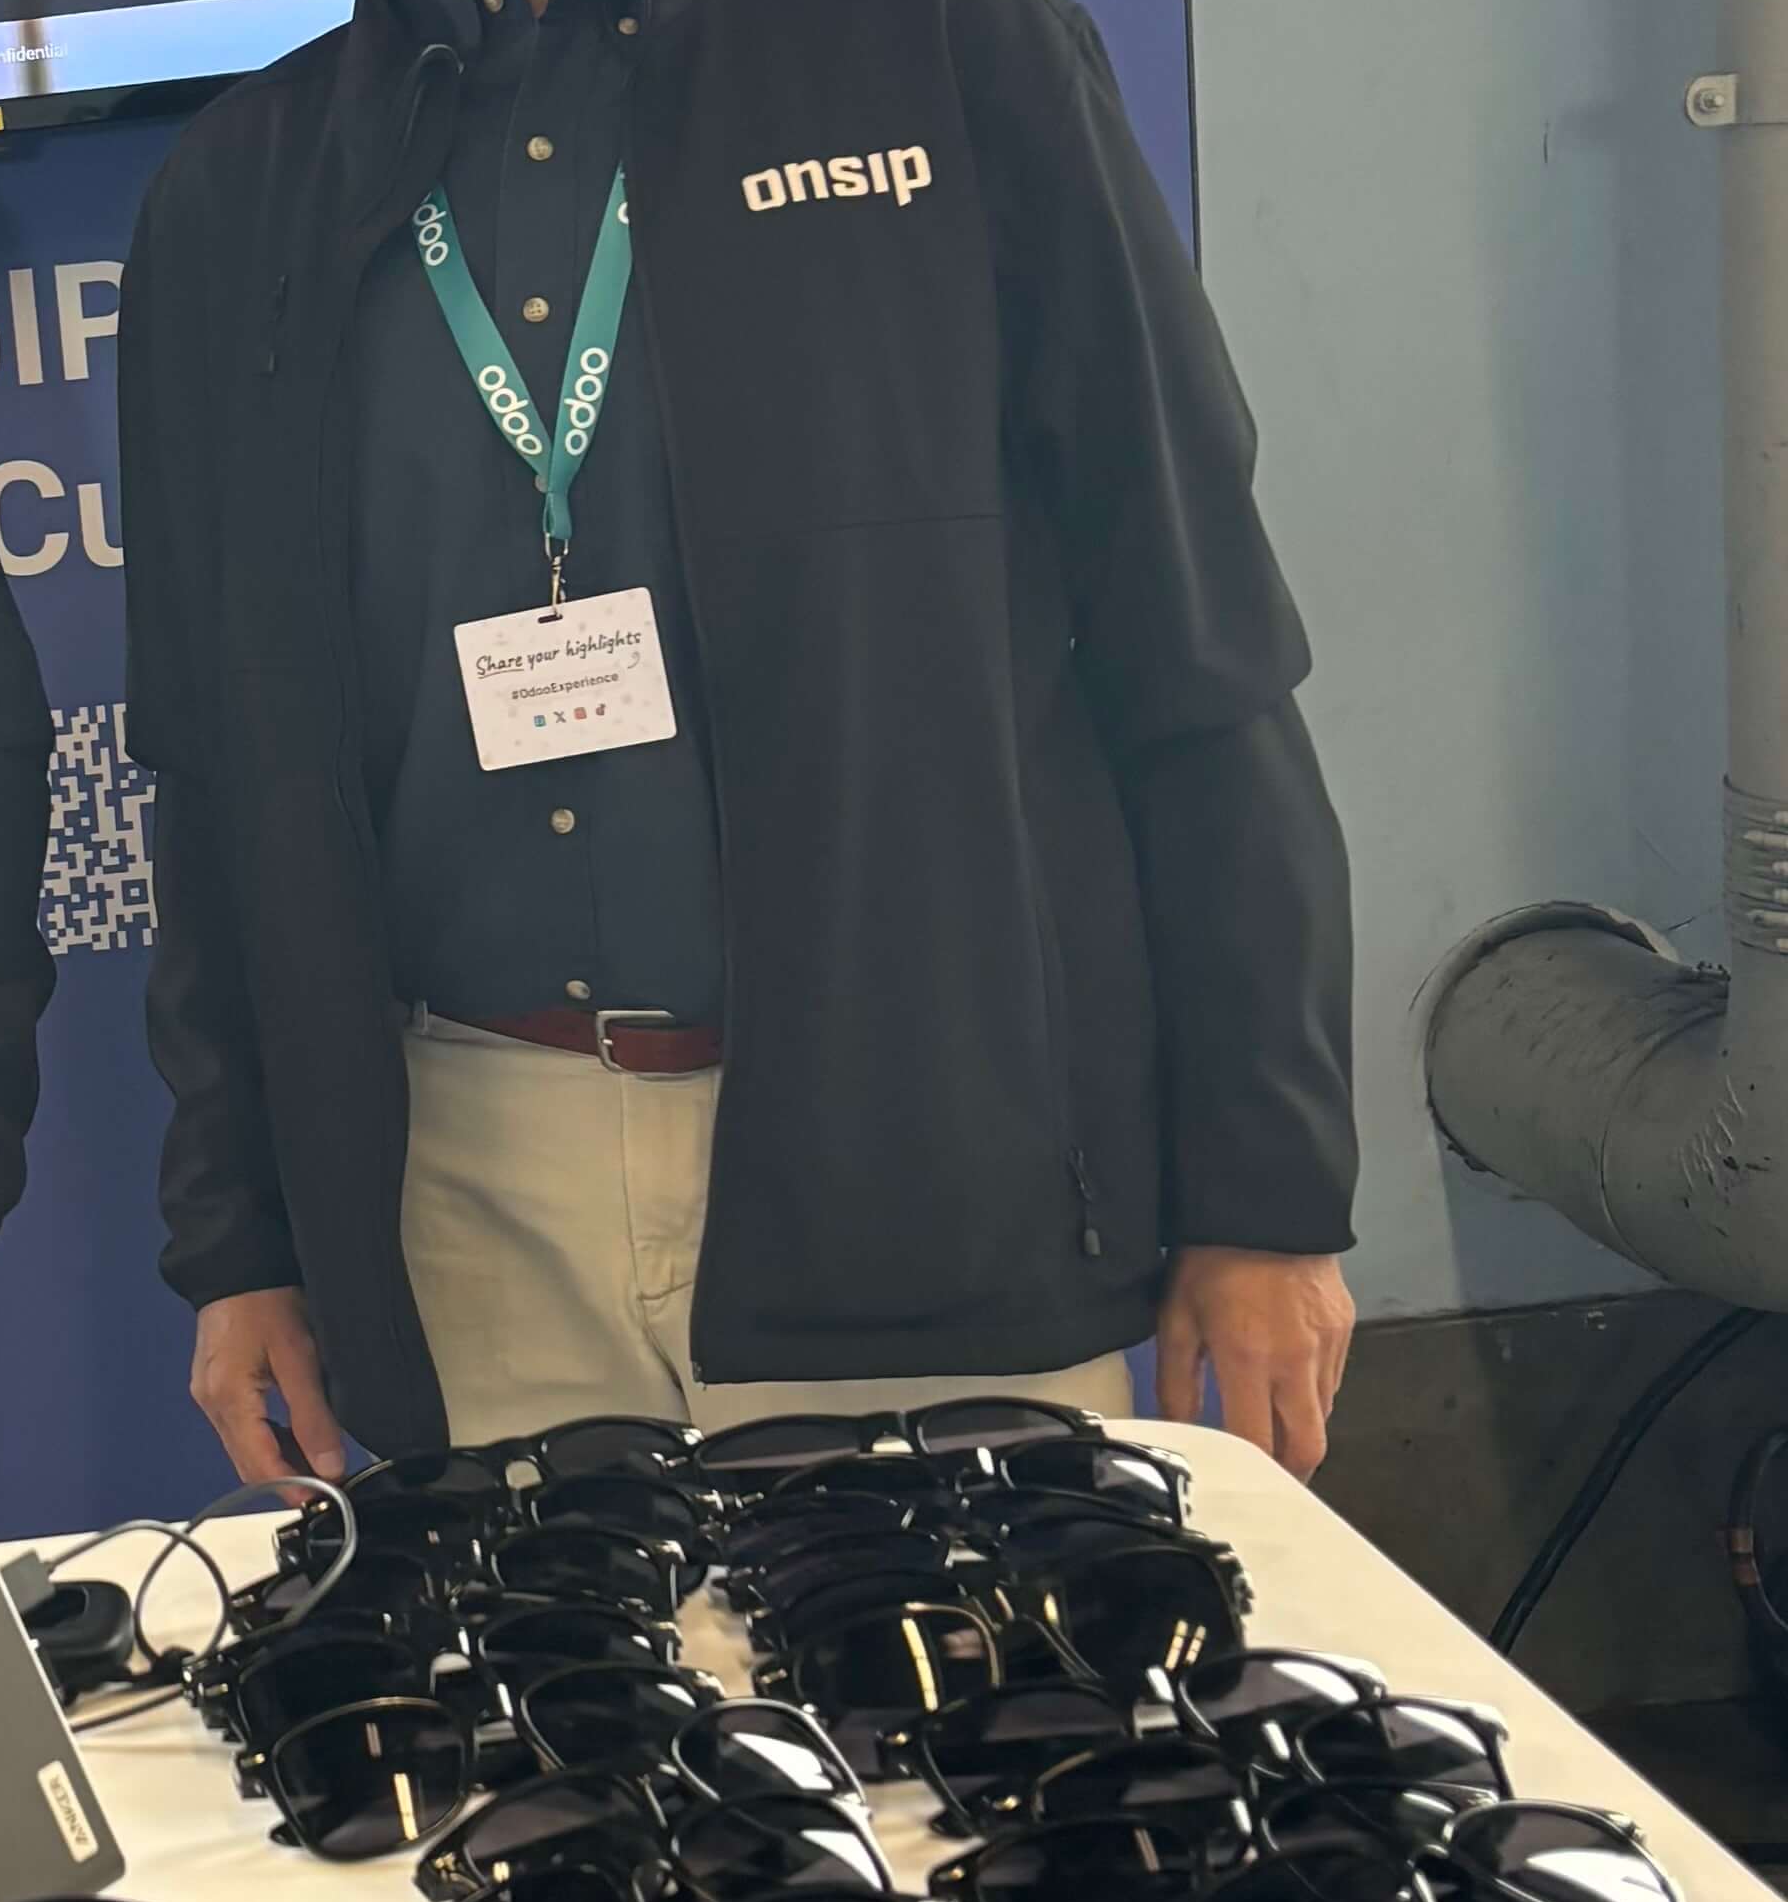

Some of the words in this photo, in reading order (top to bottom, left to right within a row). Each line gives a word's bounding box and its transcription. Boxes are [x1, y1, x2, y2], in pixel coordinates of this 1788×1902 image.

[413, 203, 448, 267] doo
[475, 654, 524, 678] Share
[527, 649, 560, 671] your
[565, 630, 642, 659] highlights
[511, 671, 620, 700] #OdooExperience
